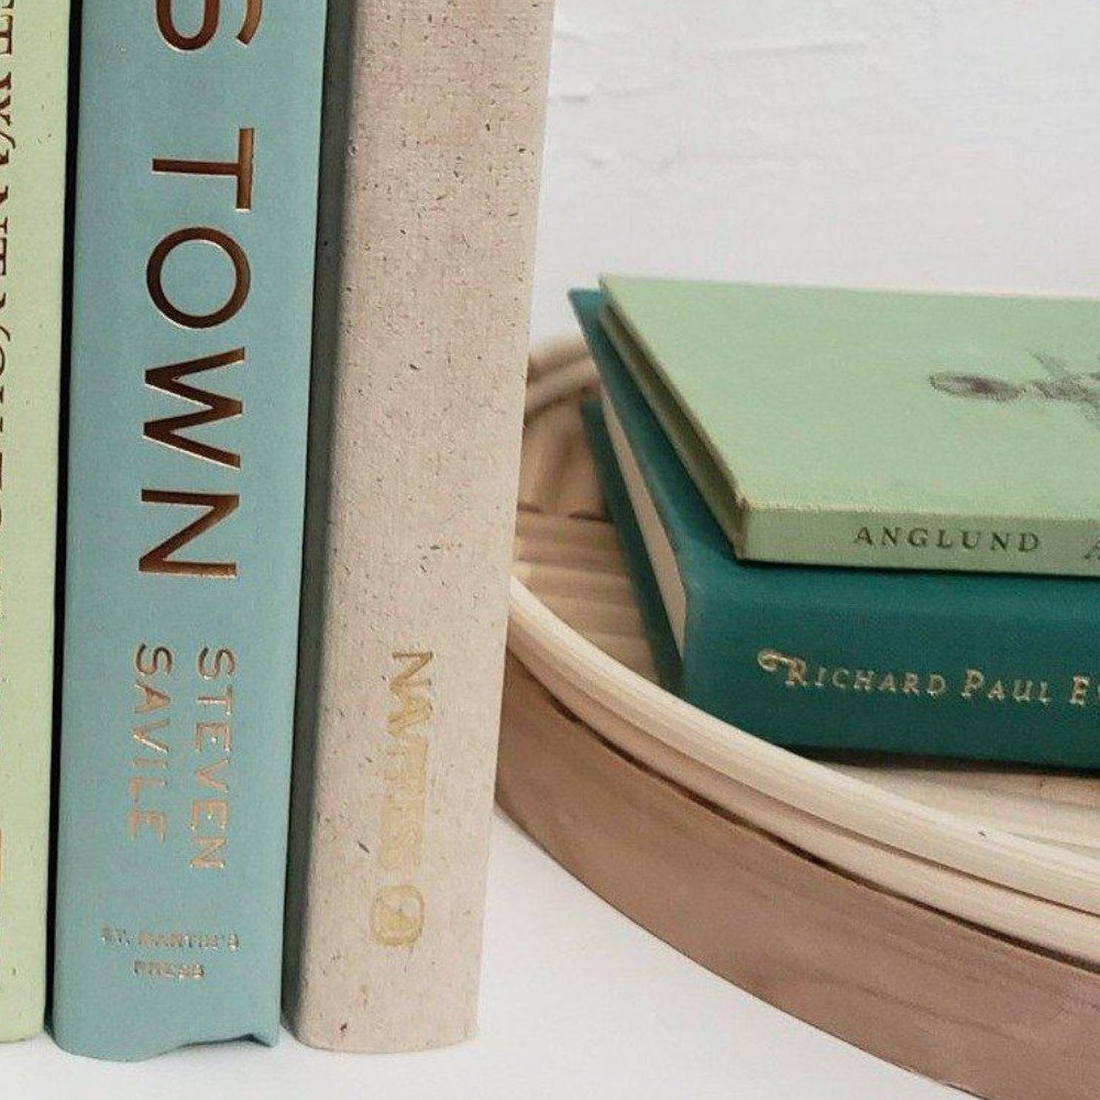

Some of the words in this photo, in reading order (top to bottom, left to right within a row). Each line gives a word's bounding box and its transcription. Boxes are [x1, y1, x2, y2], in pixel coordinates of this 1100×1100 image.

[138, 127, 254, 578] TOWN
[854, 525, 1039, 552] ANGLUND
[127, 643, 173, 843] SAVILE
[190, 646, 236, 870] STEVEN
[960, 668, 1050, 703] PAUL
